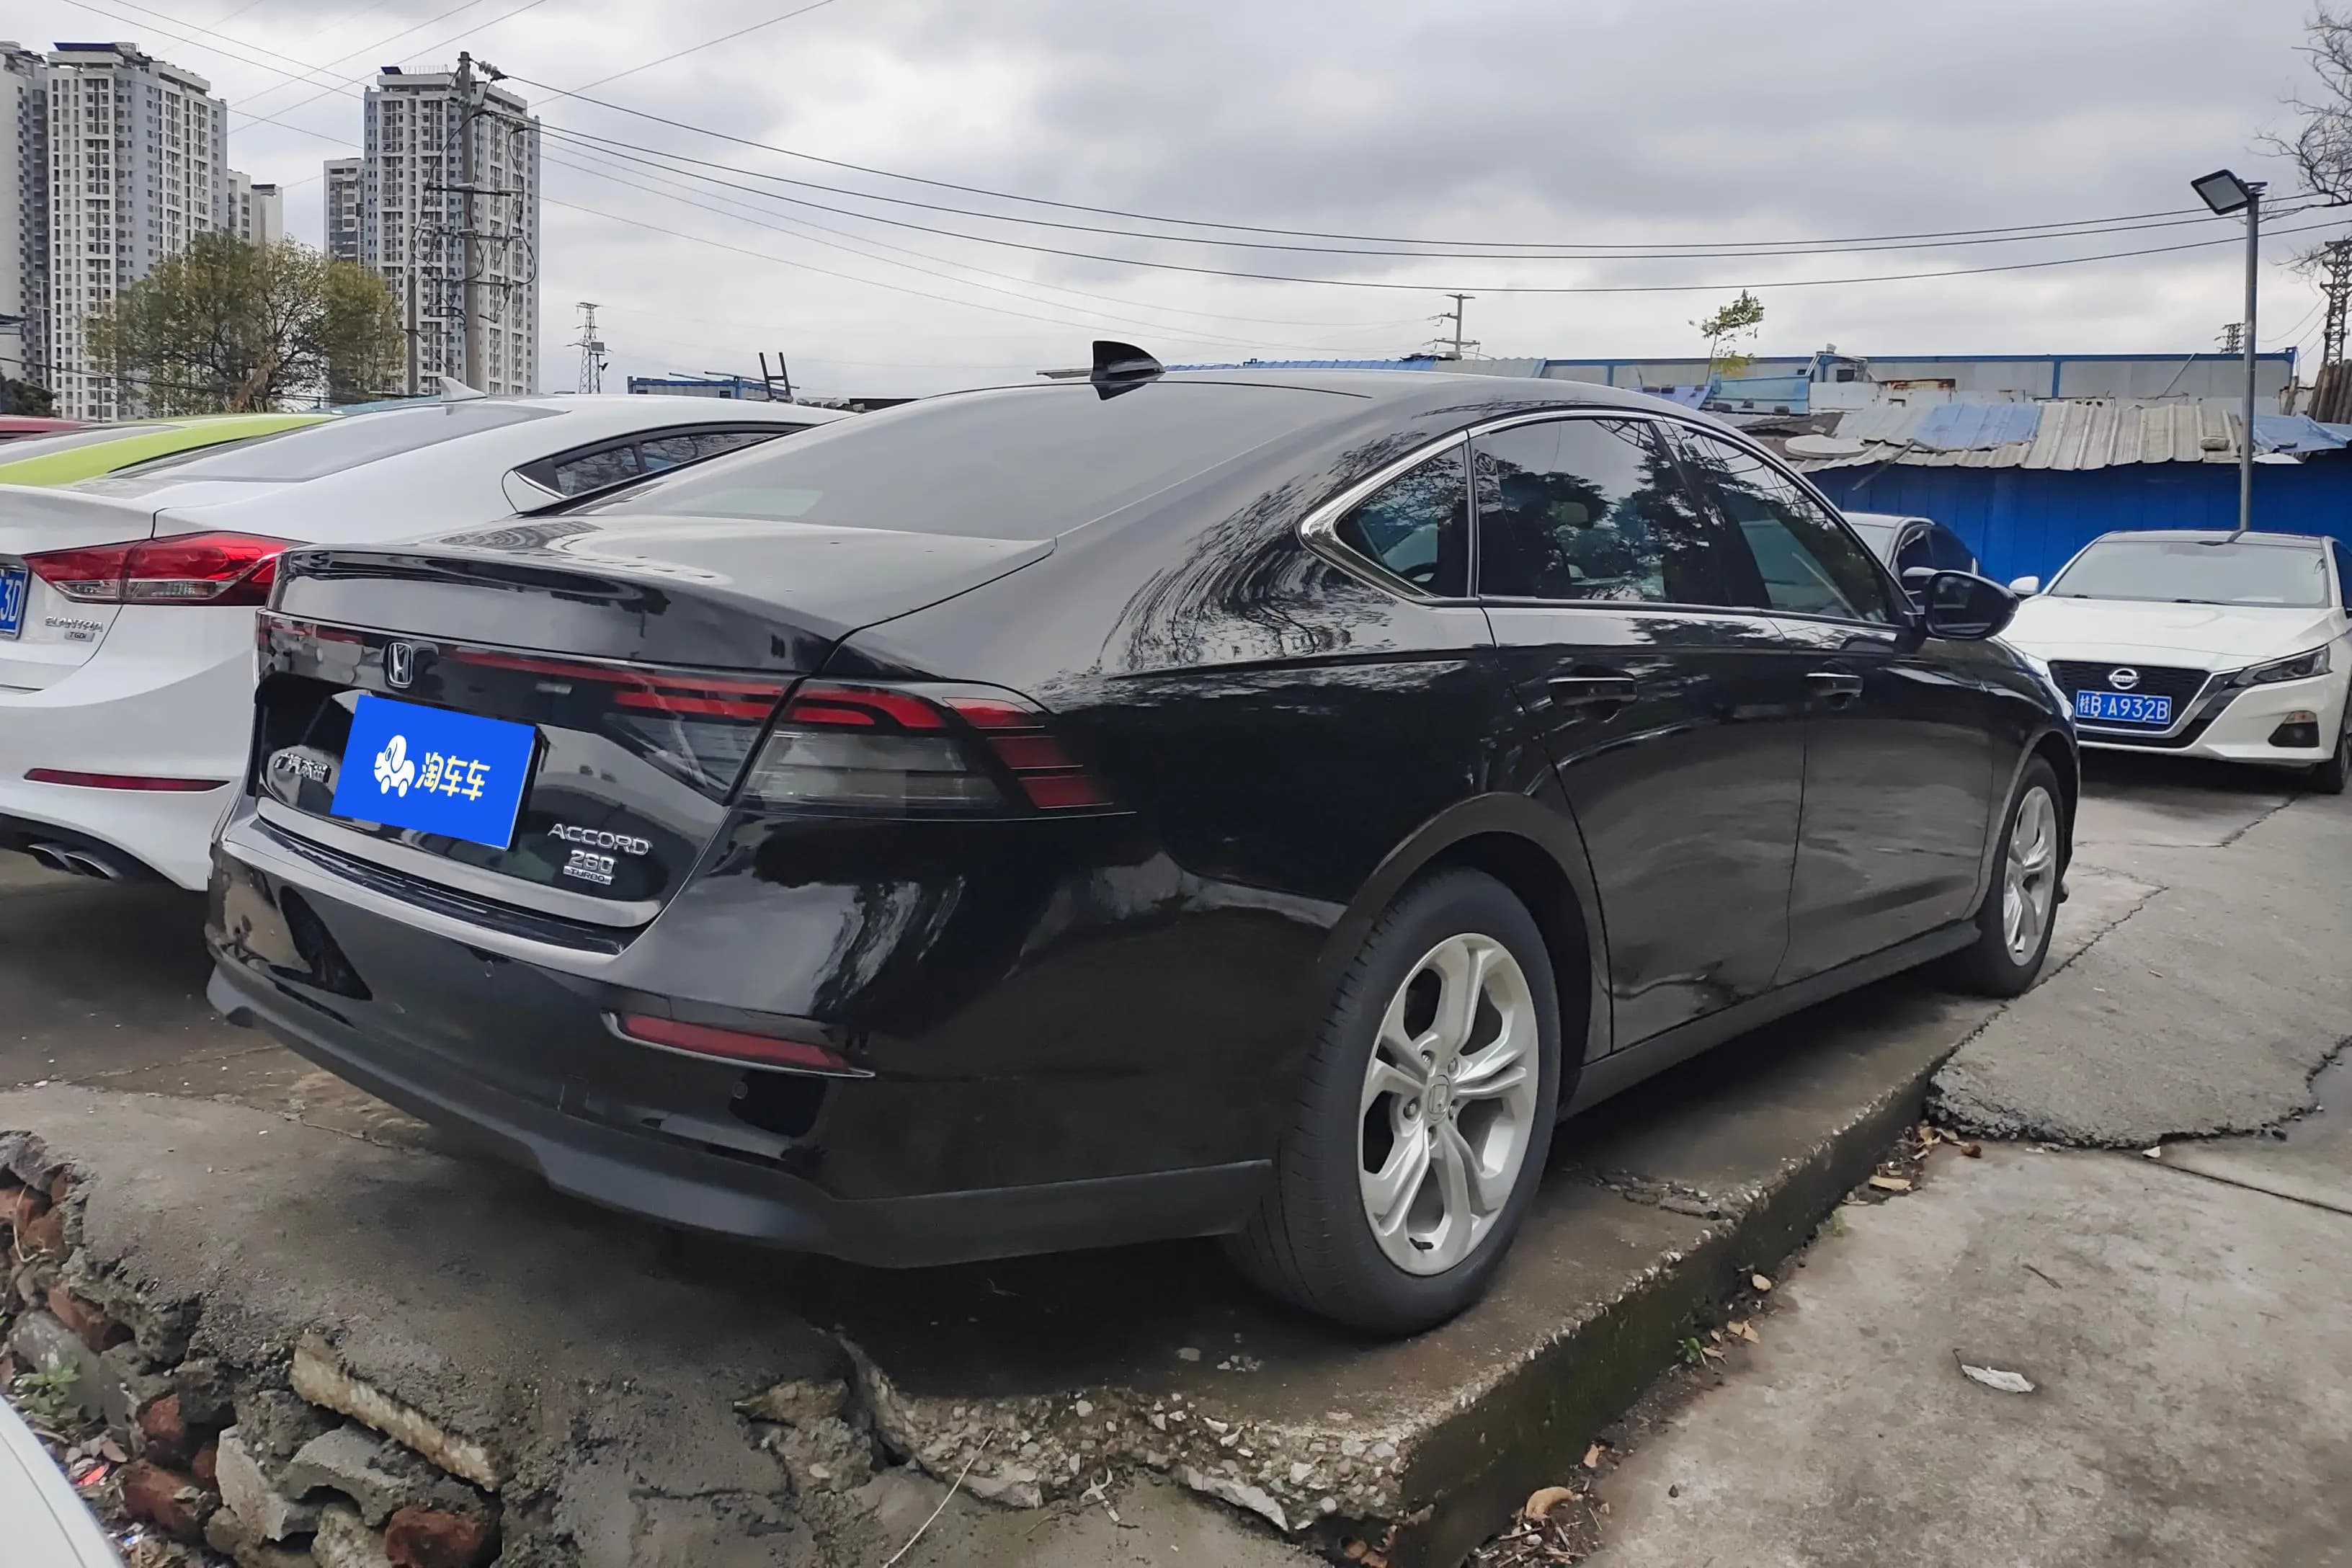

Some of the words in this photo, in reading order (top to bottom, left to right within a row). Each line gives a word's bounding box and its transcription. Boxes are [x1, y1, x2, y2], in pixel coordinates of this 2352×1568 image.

[547, 823, 653, 855] ACCORD
[569, 850, 616, 874] 260
[570, 868, 605, 882] TURBO
